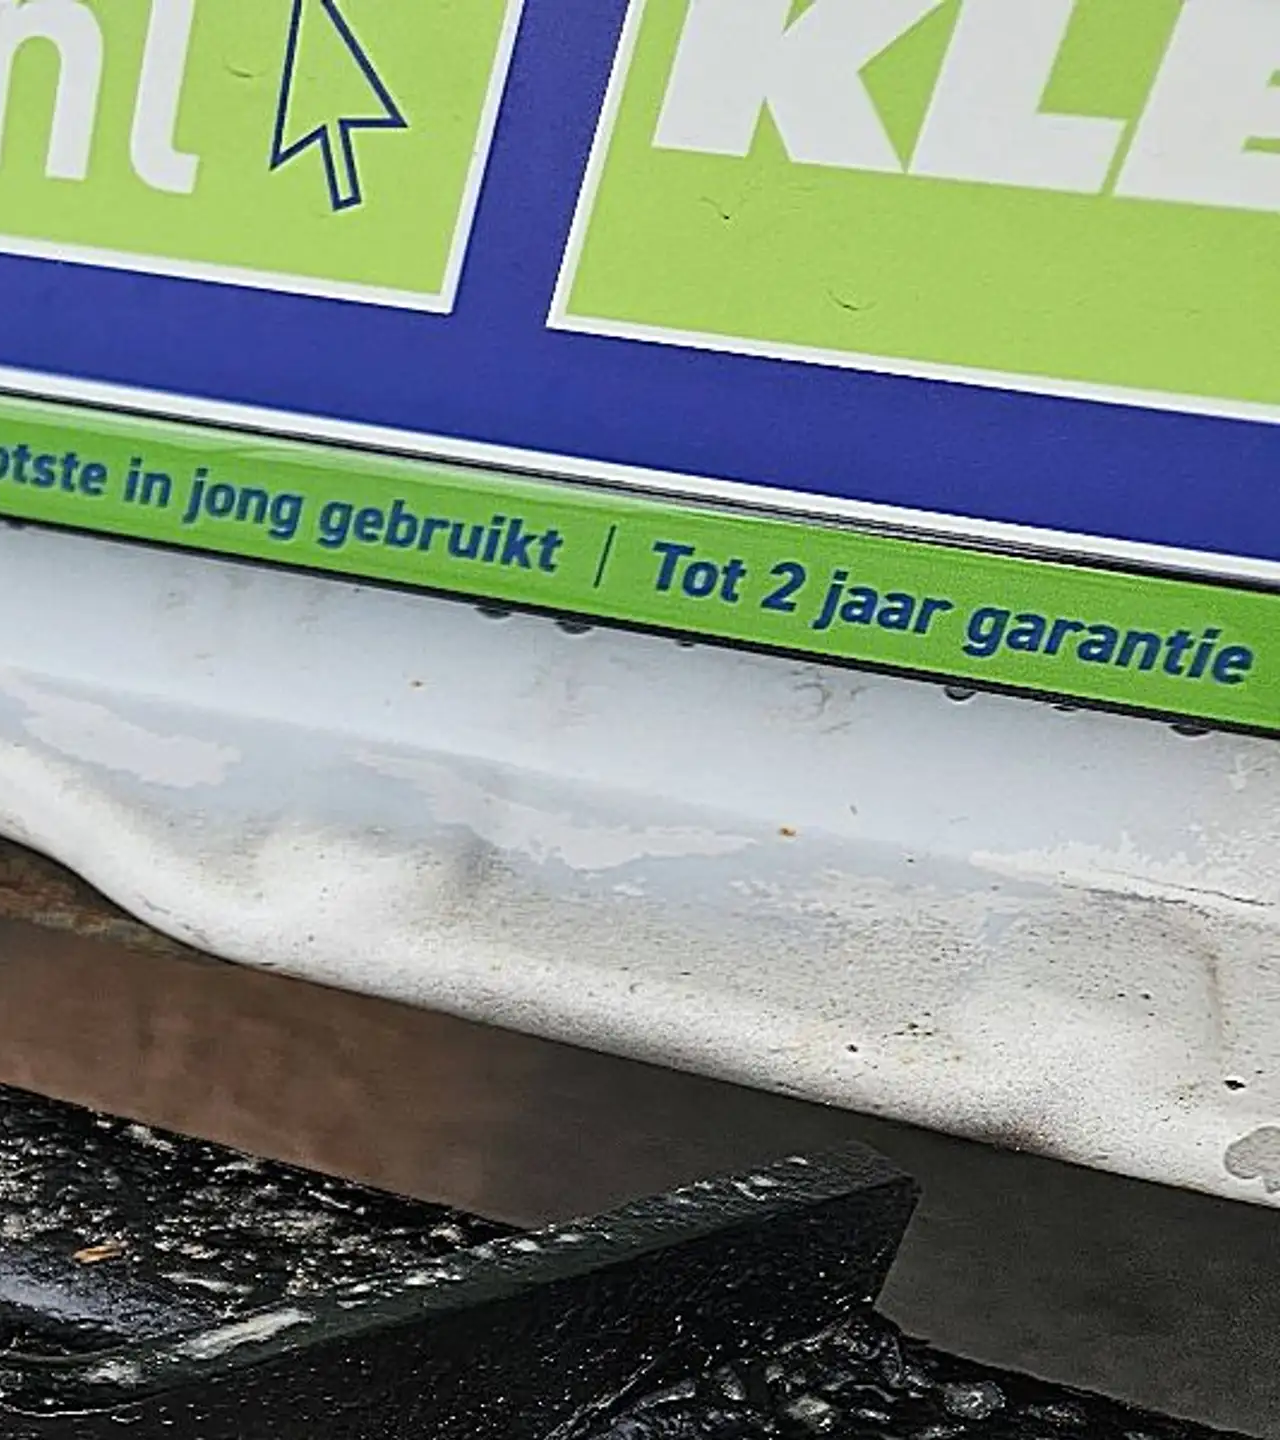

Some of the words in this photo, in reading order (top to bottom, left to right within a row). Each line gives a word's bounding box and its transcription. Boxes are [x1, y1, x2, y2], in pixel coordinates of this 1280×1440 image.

[125, 456, 171, 508] in
[183, 467, 304, 540] jong
[319, 500, 564, 572] gebruikt
[652, 541, 748, 604] Tot
[761, 561, 807, 613] 2
[812, 570, 951, 633] jaar
[963, 607, 1254, 685] garantie
